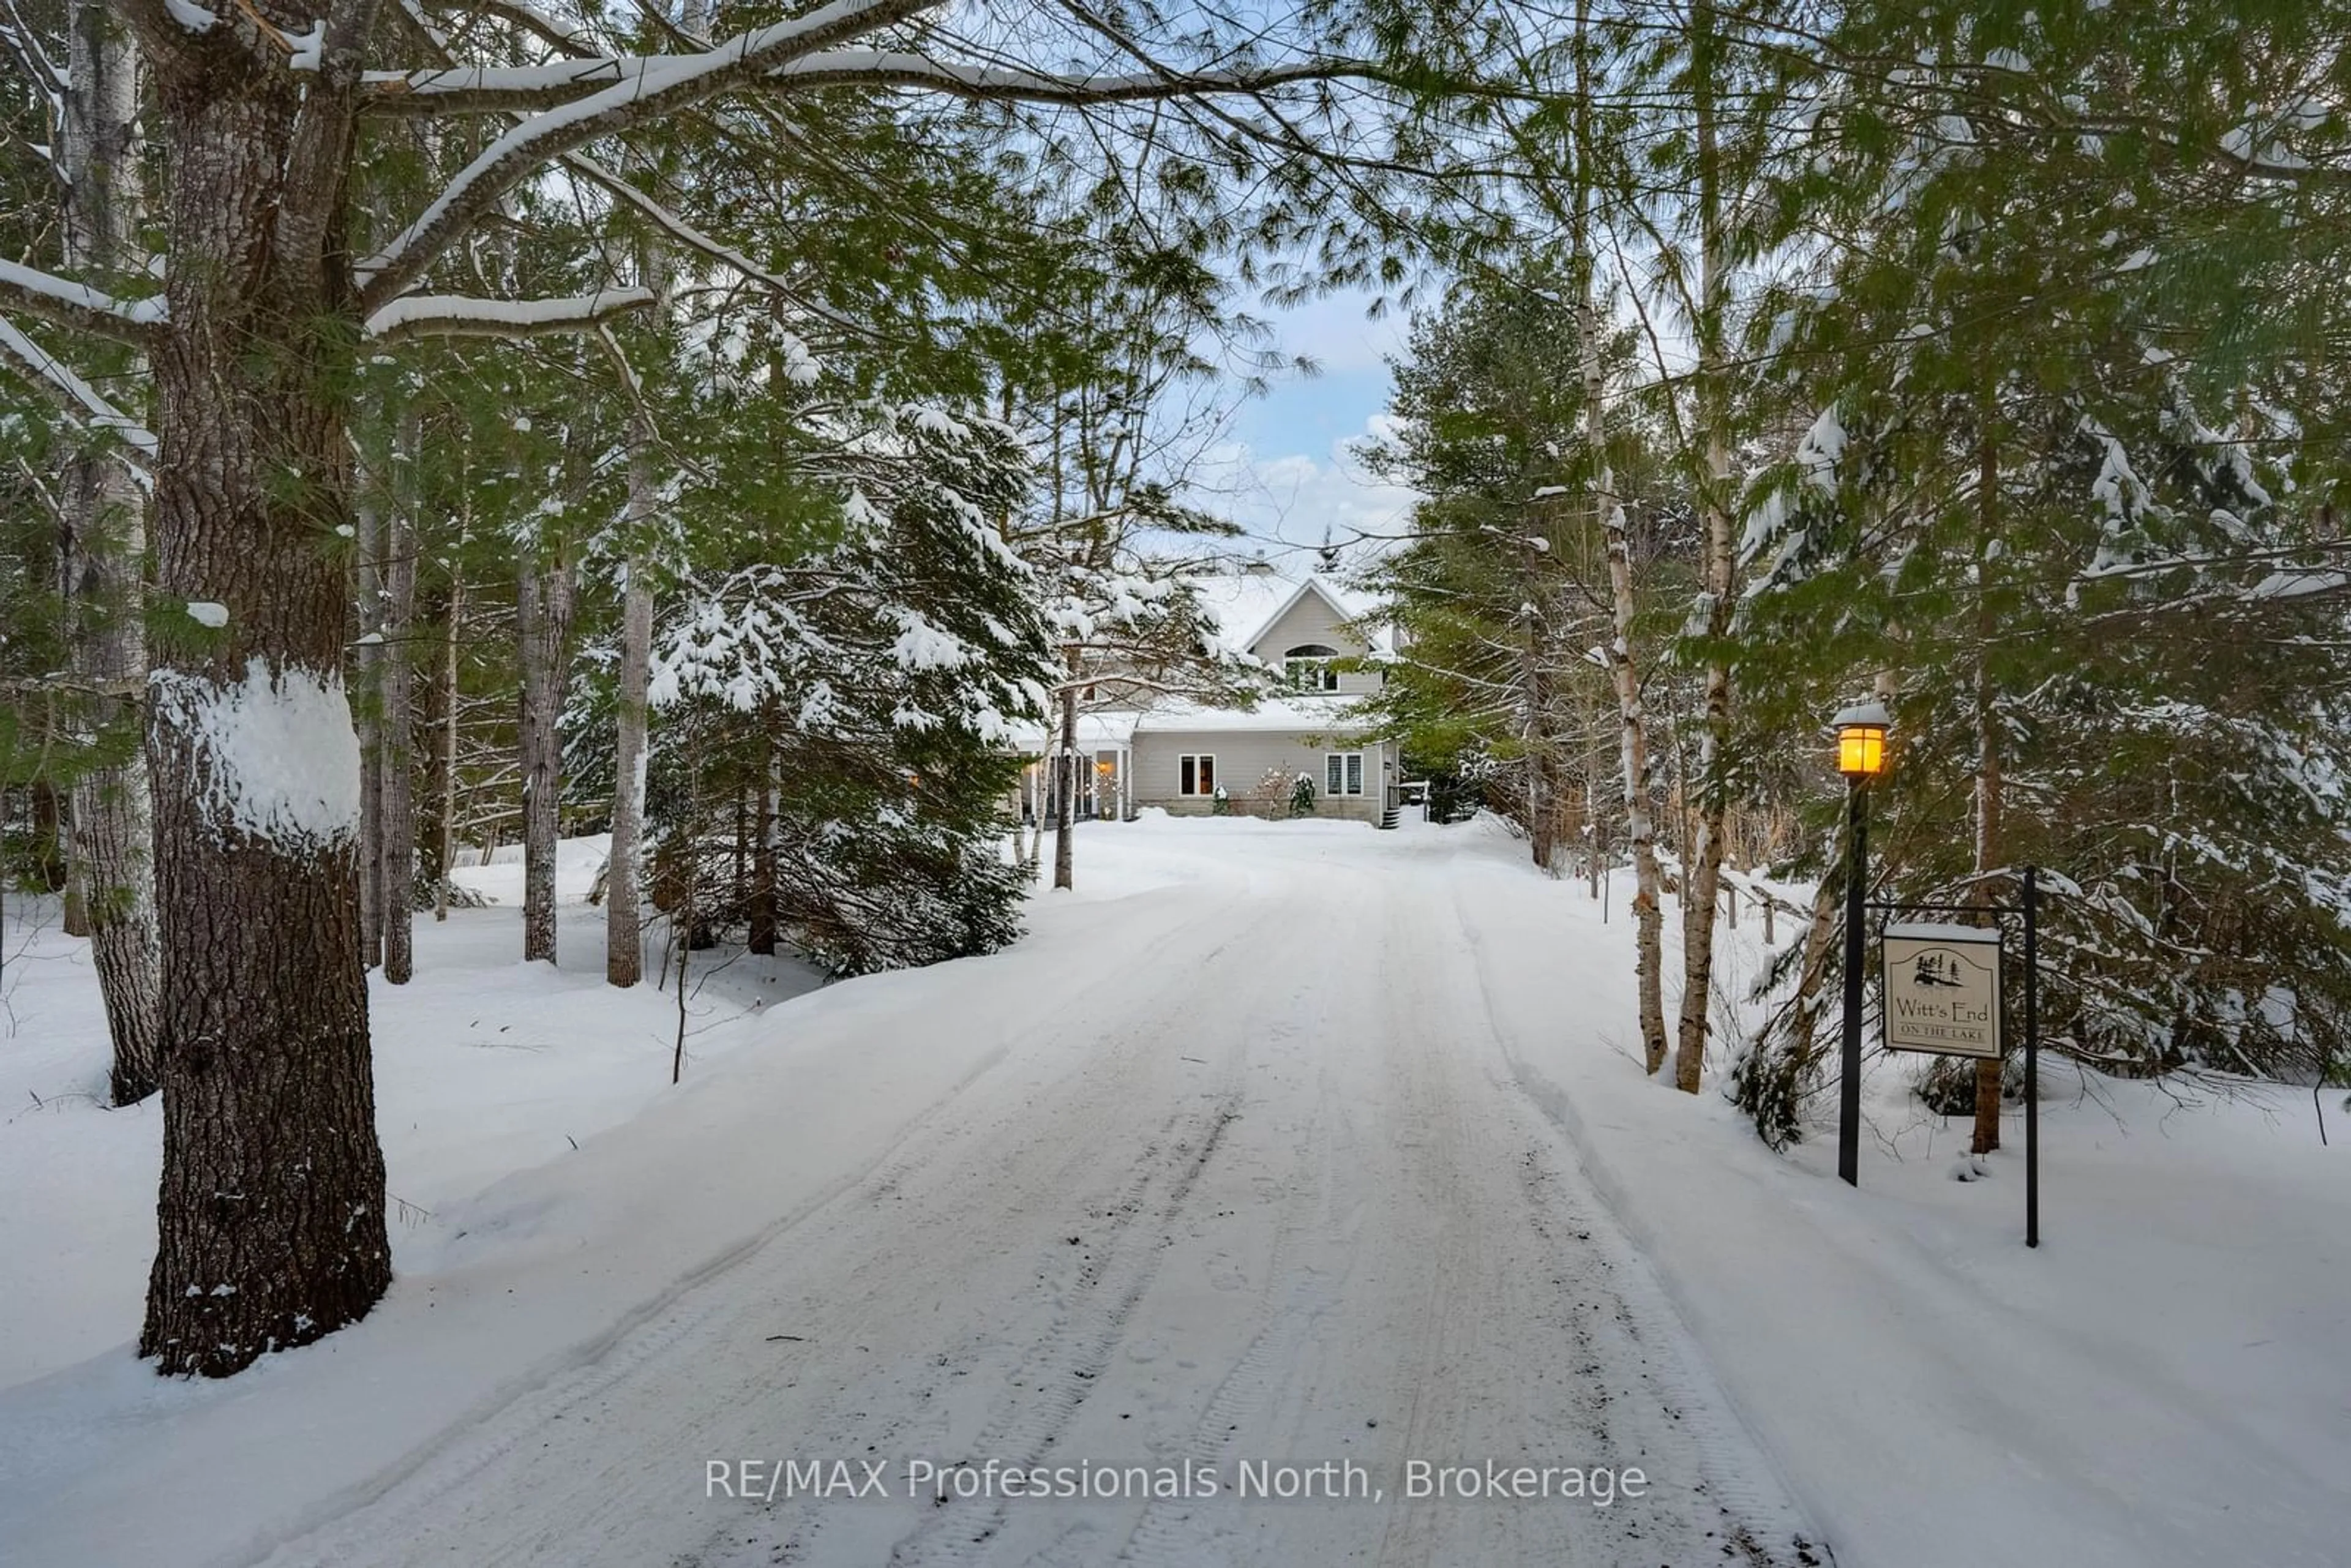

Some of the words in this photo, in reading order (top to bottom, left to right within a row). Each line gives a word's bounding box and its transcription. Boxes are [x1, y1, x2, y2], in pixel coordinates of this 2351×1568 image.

[1897, 997, 1948, 1018] Witt's
[1952, 1002, 1987, 1022] End
[1901, 1024, 1919, 1033] ON
[1924, 1026, 1945, 1036] THE
[1952, 1029, 1982, 1040] LAKE
